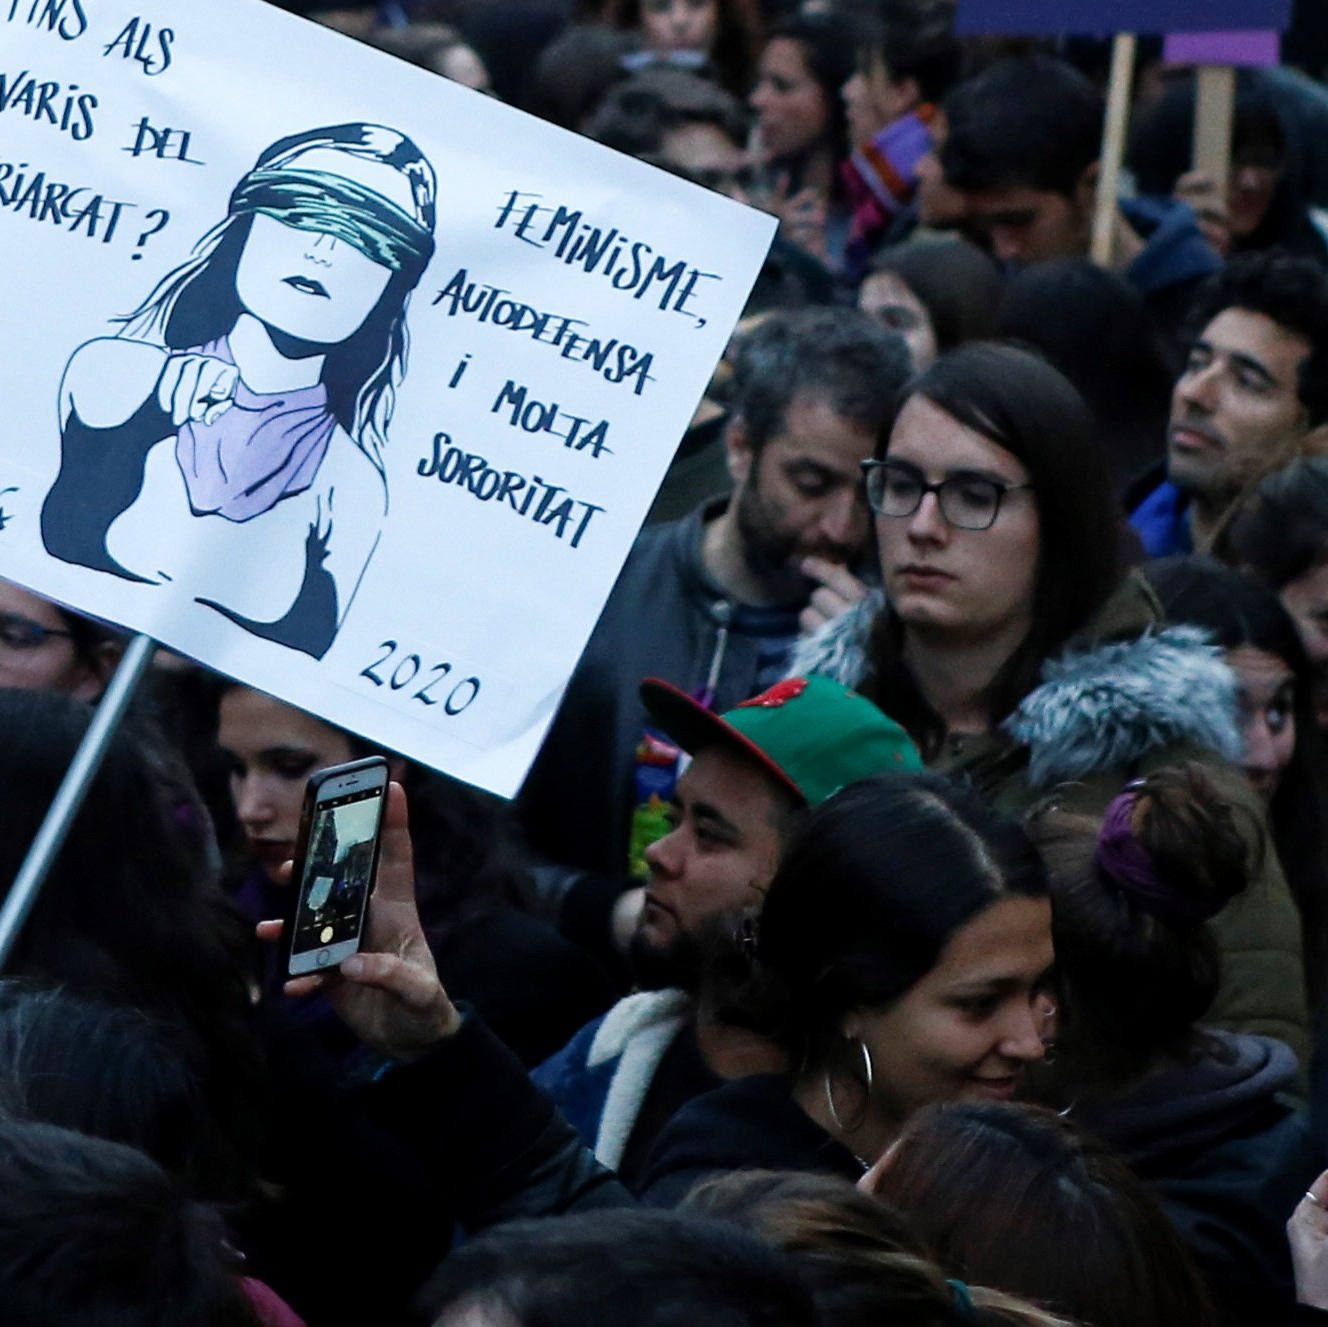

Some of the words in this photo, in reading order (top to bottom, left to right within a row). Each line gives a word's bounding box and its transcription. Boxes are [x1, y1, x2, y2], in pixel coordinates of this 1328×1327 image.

[103, 16, 175, 76] ALS
[121, 117, 206, 165] DEL
[431, 268, 657, 396] AUTODEFENSA
[491, 380, 615, 459] MOLTA
[359, 640, 481, 716] 2020
